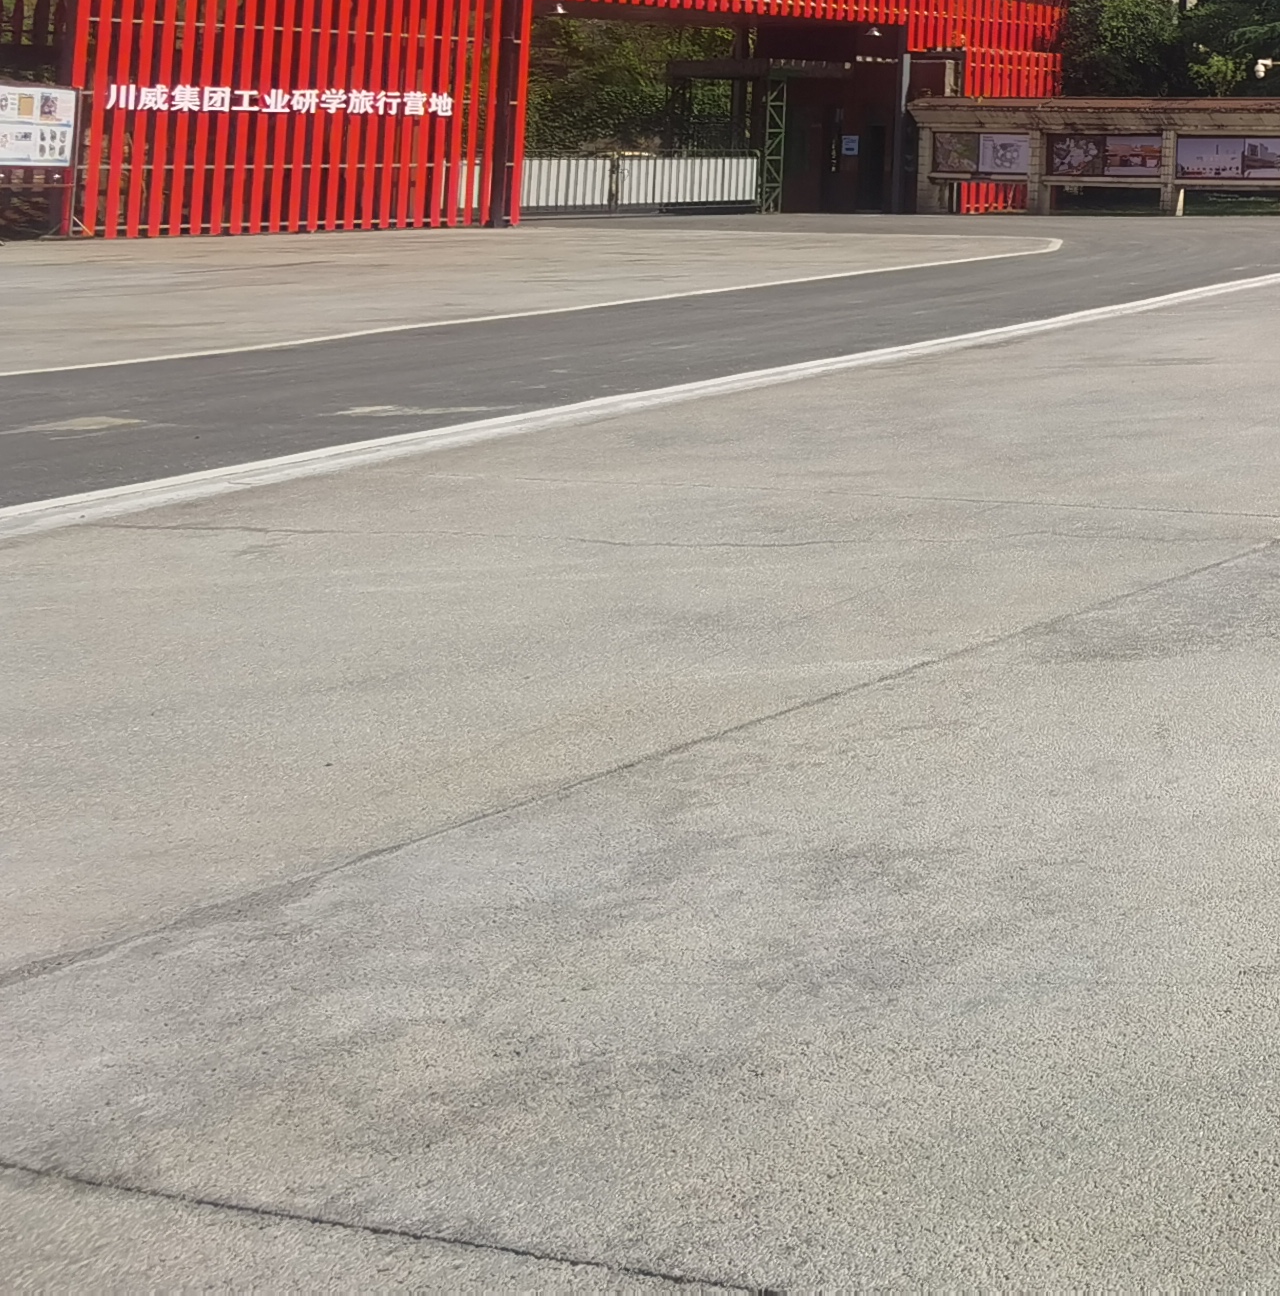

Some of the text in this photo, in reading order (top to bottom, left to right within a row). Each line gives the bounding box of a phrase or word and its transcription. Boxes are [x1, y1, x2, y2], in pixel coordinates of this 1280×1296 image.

[106, 84, 454, 117] 川威集团工业研学旅行营地
